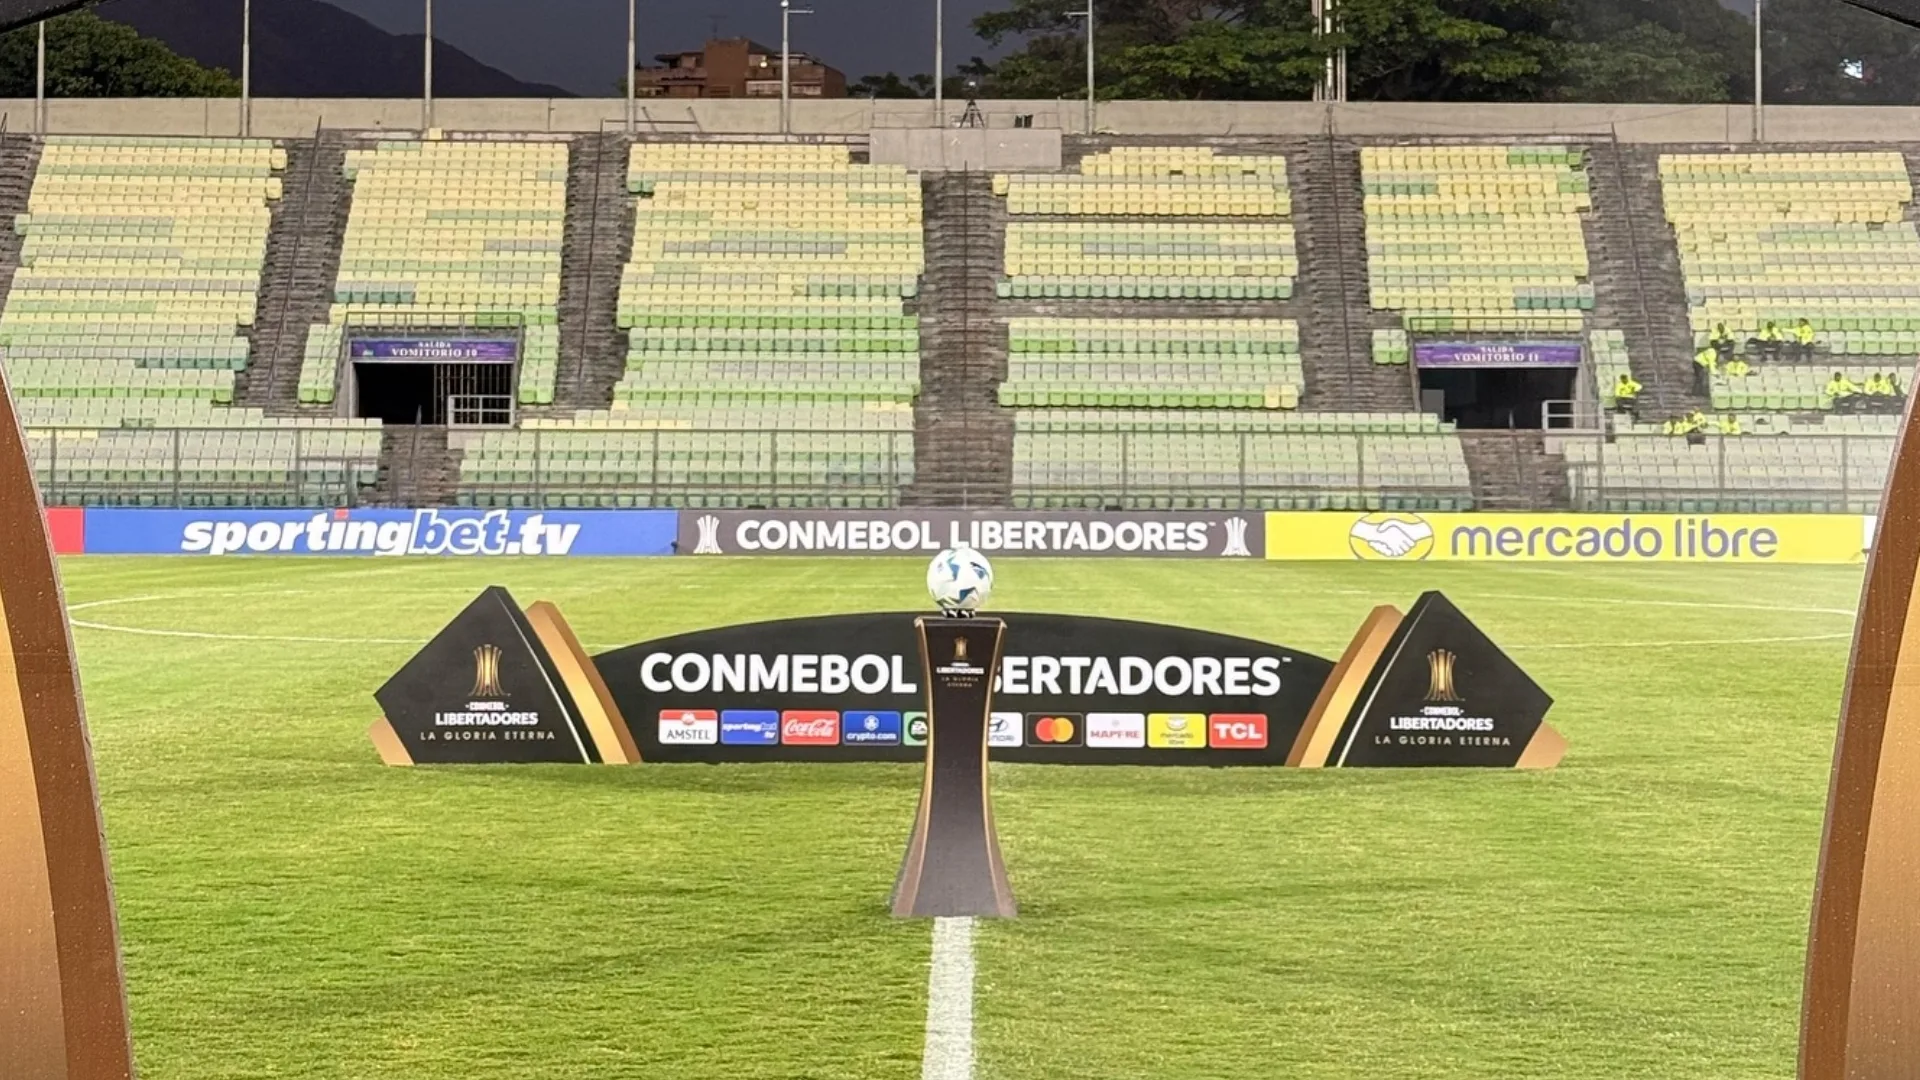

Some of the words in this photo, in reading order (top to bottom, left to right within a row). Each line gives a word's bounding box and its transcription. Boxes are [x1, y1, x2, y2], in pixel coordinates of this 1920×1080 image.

[391, 348, 462, 357] VOMITORIO
[465, 348, 478, 357] 10
[1454, 353, 1525, 362] VOMITORIO
[181, 508, 582, 555] sportingbet.tv
[735, 519, 941, 550] CONMEBOL
[950, 520, 1209, 551] LIBERTADORES
[1451, 518, 1663, 558] mercado
[1675, 518, 1778, 558] libre
[640, 652, 918, 694] CONMEBOL
[994, 656, 1281, 696] ERTADORES
[435, 712, 539, 726] LIBERTADORES
[1390, 716, 1494, 731] LIBERTADORES
[420, 731, 436, 740] LA
[444, 731, 497, 740] GLORIA
[504, 731, 555, 741] ETERNA
[666, 729, 711, 740] AMSTEL
[846, 732, 897, 742] crypto.com
[1090, 730, 1140, 739] MAPFRE
[1213, 722, 1263, 740] TCL
[1375, 735, 1391, 745] LA
[1399, 736, 1452, 745] GLORIA
[1459, 736, 1511, 746] ETERNA
